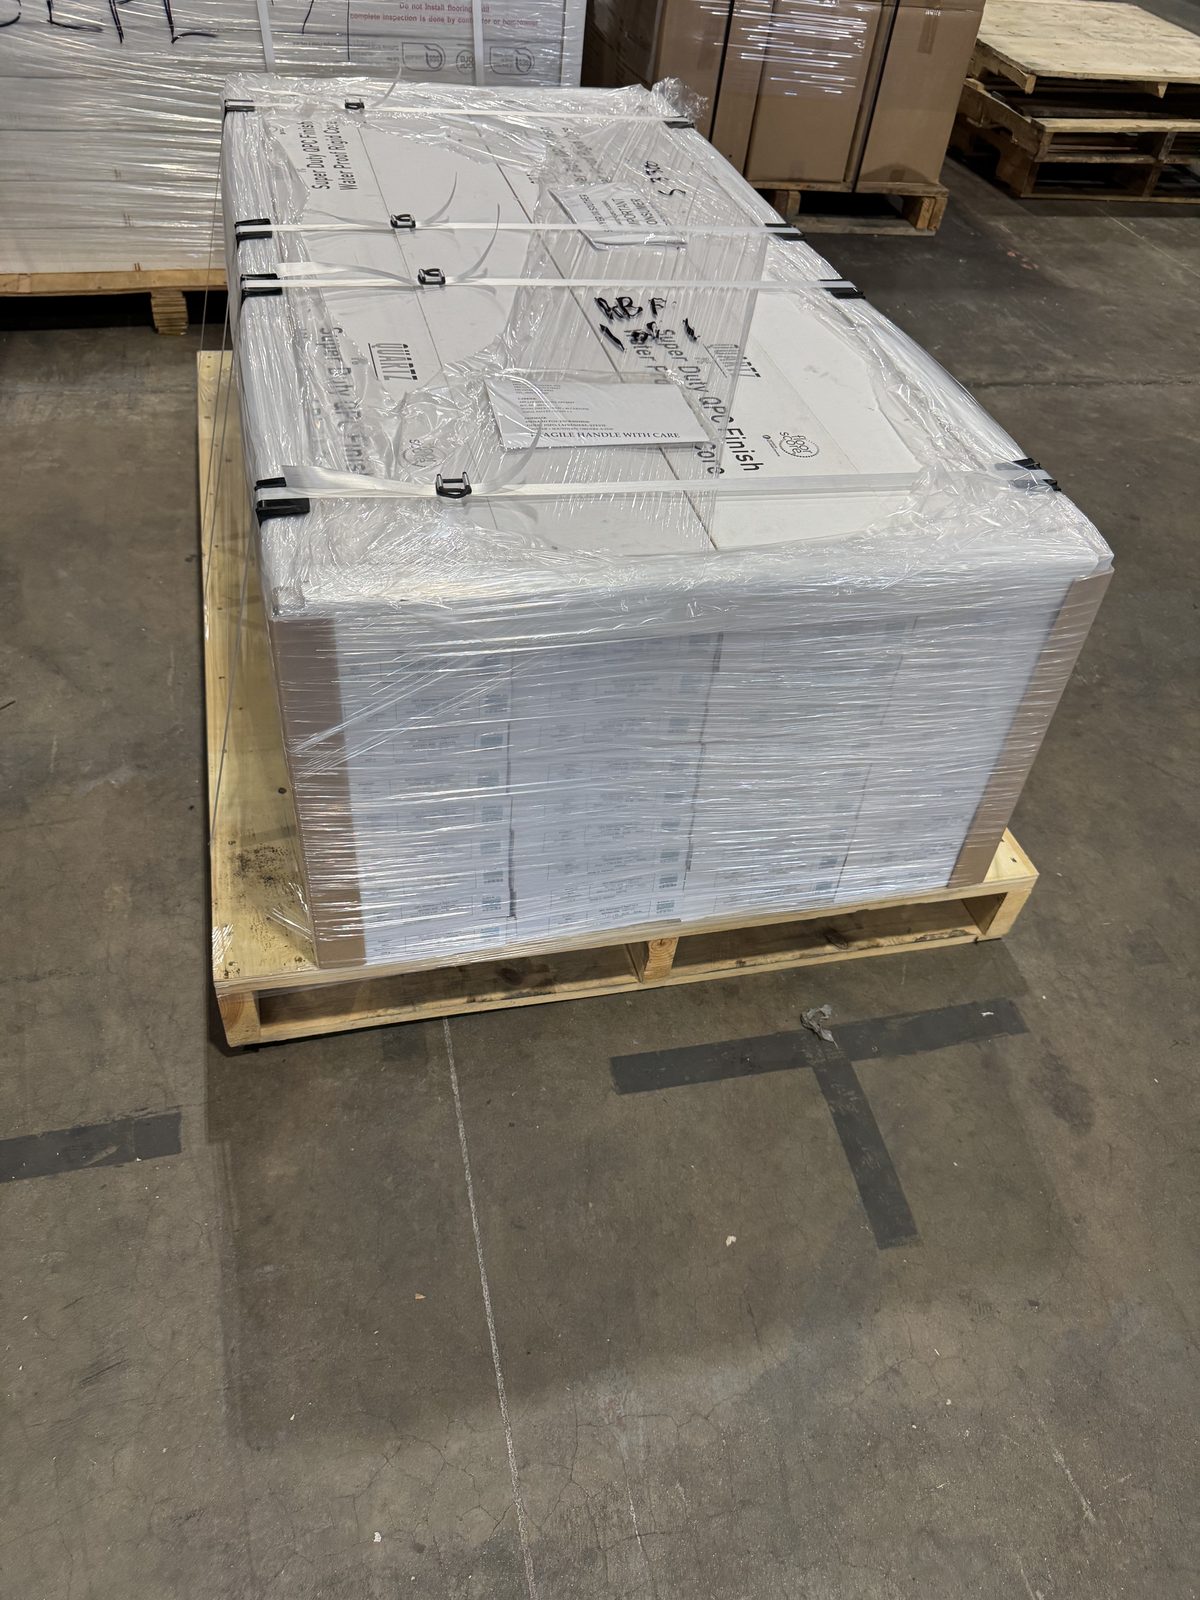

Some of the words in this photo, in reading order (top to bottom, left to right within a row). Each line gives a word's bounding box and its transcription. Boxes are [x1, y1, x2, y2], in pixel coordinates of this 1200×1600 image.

[296, 121, 317, 138] Finish
[300, 139, 321, 152] QPC
[305, 153, 327, 169] Duty
[328, 151, 352, 169] Proof
[311, 169, 334, 190] Super
[338, 170, 359, 190] Water
[370, 342, 418, 381] QUARTZ
[677, 366, 709, 390] Duty
[718, 426, 764, 471] Finish
